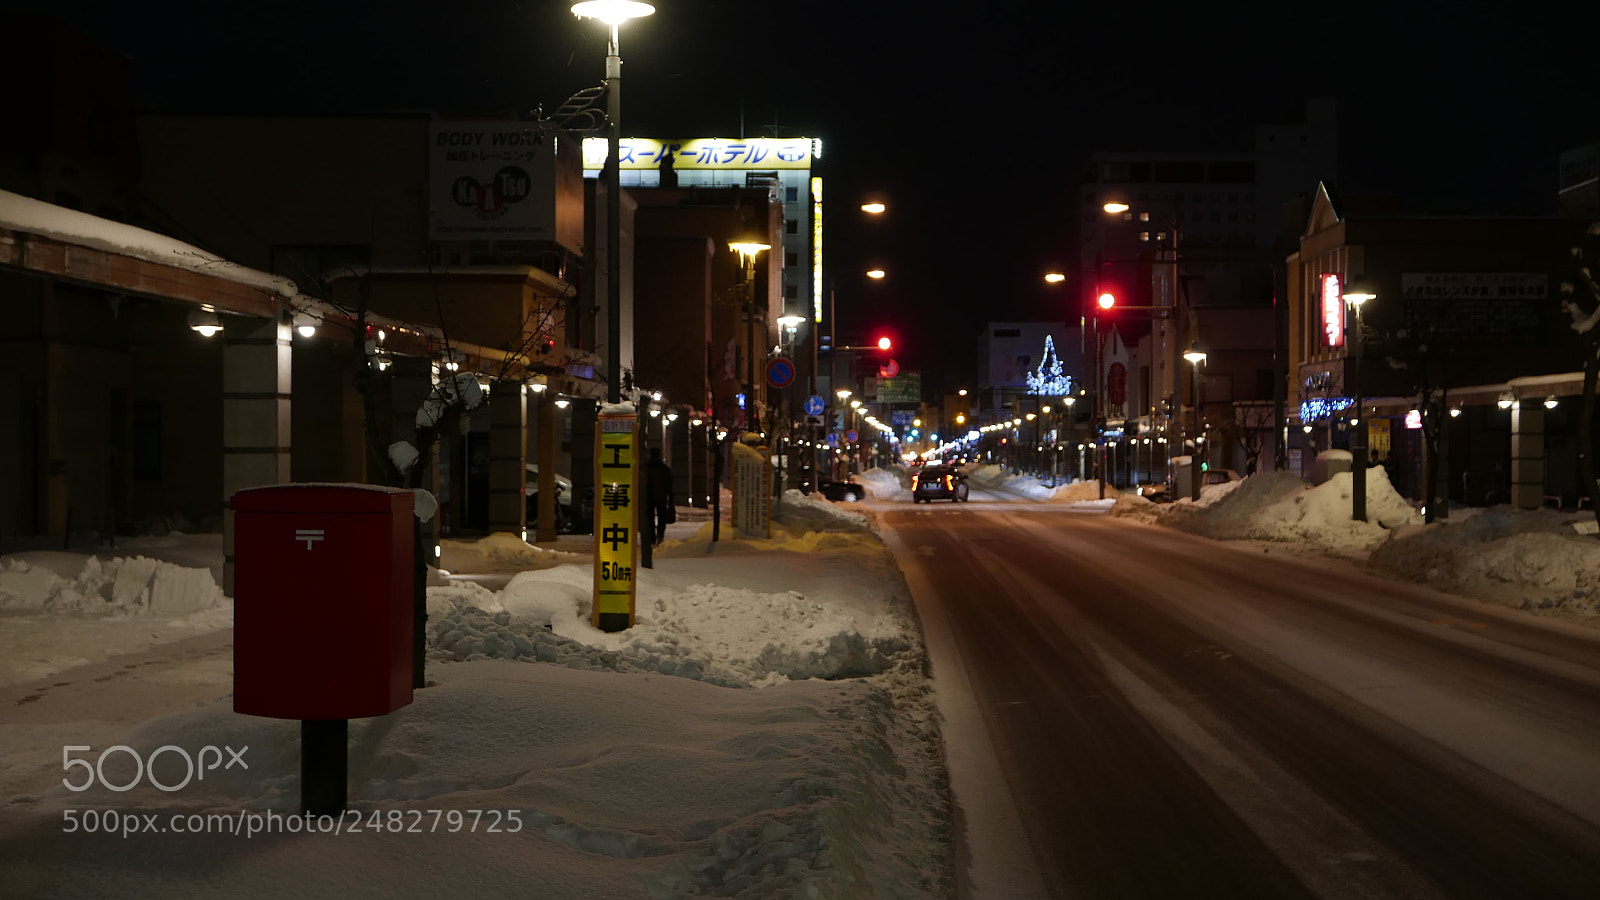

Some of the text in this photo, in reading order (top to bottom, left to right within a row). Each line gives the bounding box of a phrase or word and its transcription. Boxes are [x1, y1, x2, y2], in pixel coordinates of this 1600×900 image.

[436, 131, 545, 146] BODY WORK
[619, 144, 769, 164] スーパーホテル
[602, 444, 631, 551] 工事中
